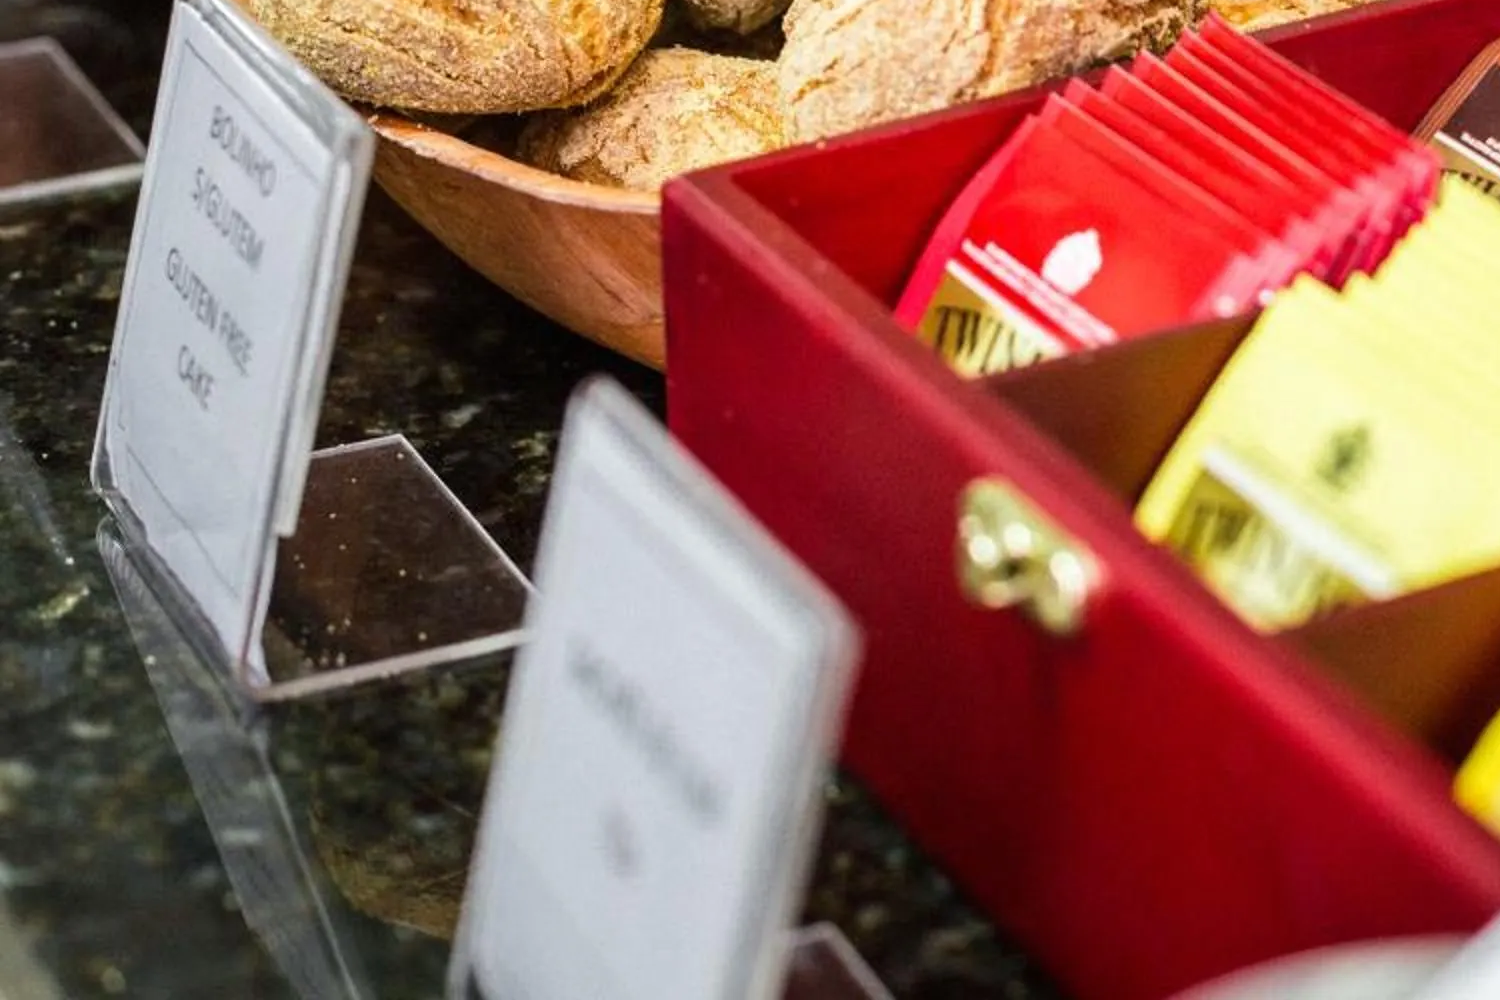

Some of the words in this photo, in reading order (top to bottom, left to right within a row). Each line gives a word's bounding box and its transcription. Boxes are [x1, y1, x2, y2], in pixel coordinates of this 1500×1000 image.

[209, 105, 277, 198] BOLINHO
[166, 247, 219, 331] GLUTEN
[177, 344, 214, 411] CAKE
